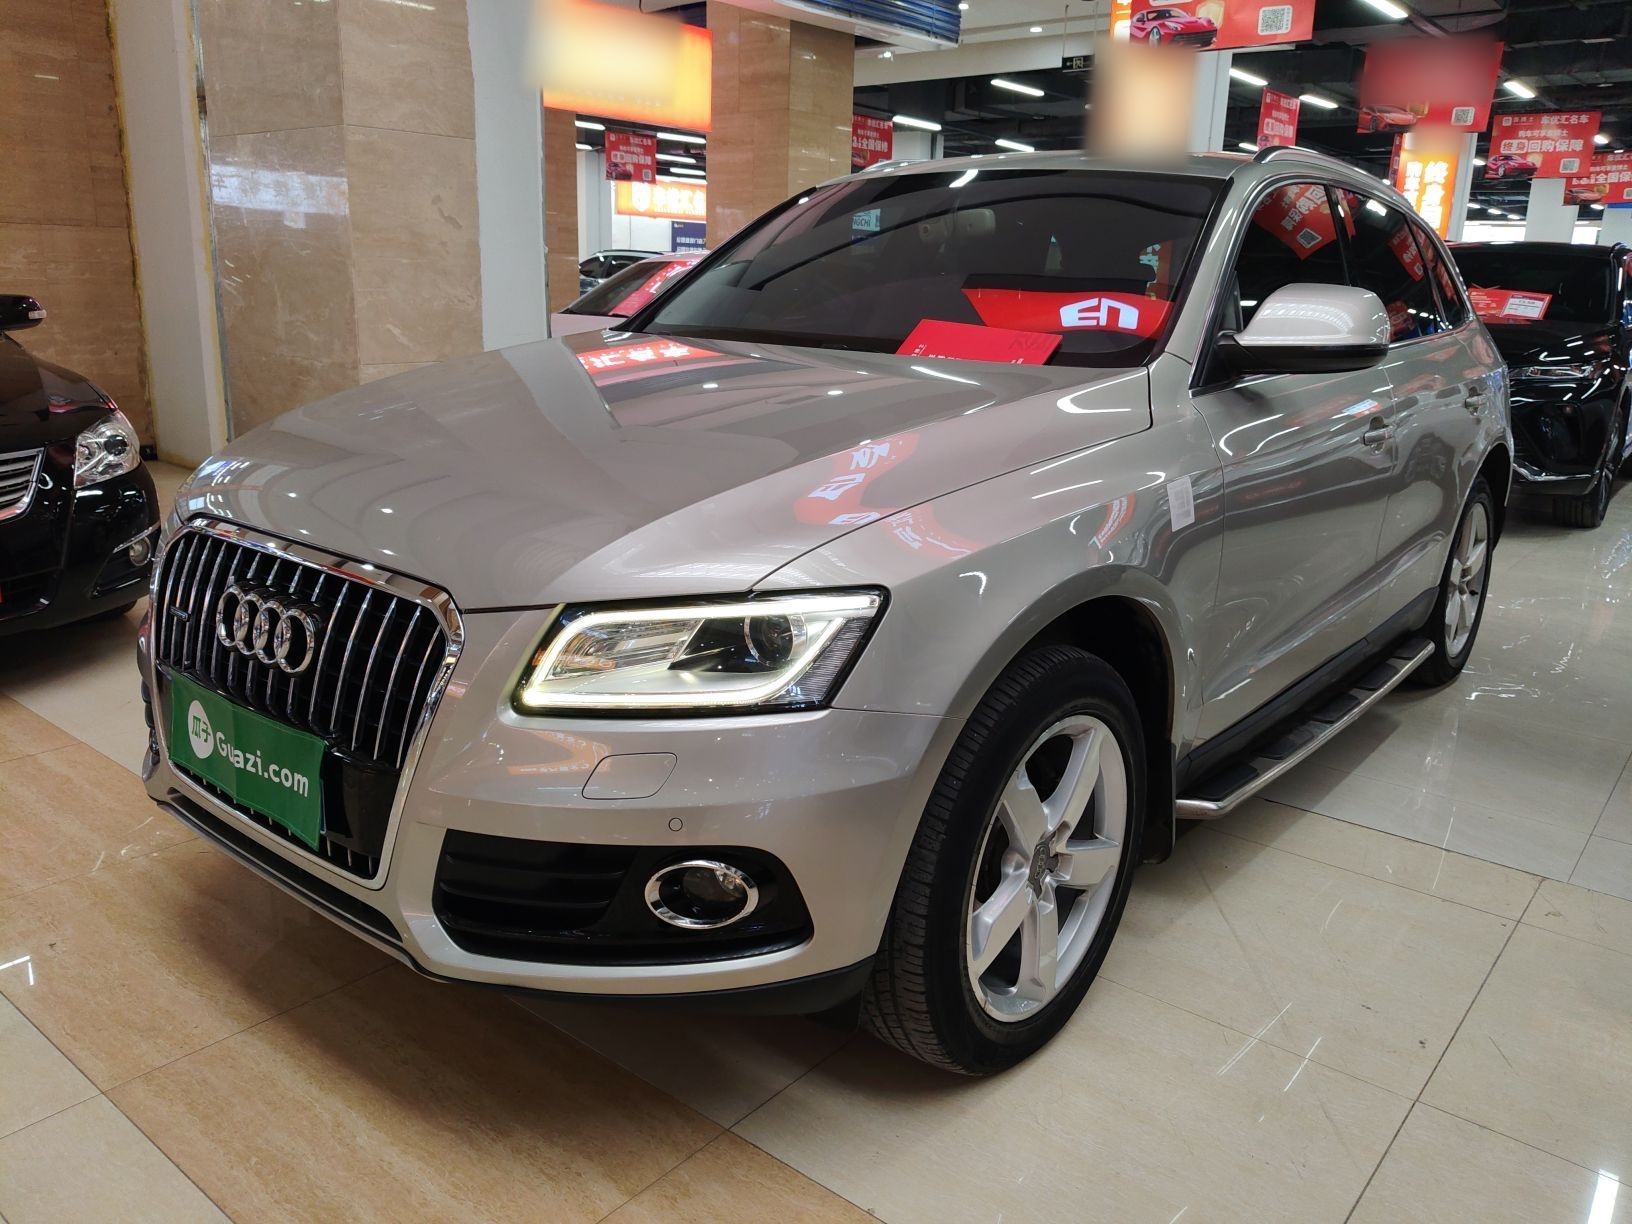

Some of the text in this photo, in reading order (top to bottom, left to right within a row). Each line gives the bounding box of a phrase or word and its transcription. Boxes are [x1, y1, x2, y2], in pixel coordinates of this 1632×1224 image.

[1501, 139, 1585, 154] 终身回购保障
[191, 715, 212, 744] 瓜子
[215, 731, 309, 797] Guazi.com
